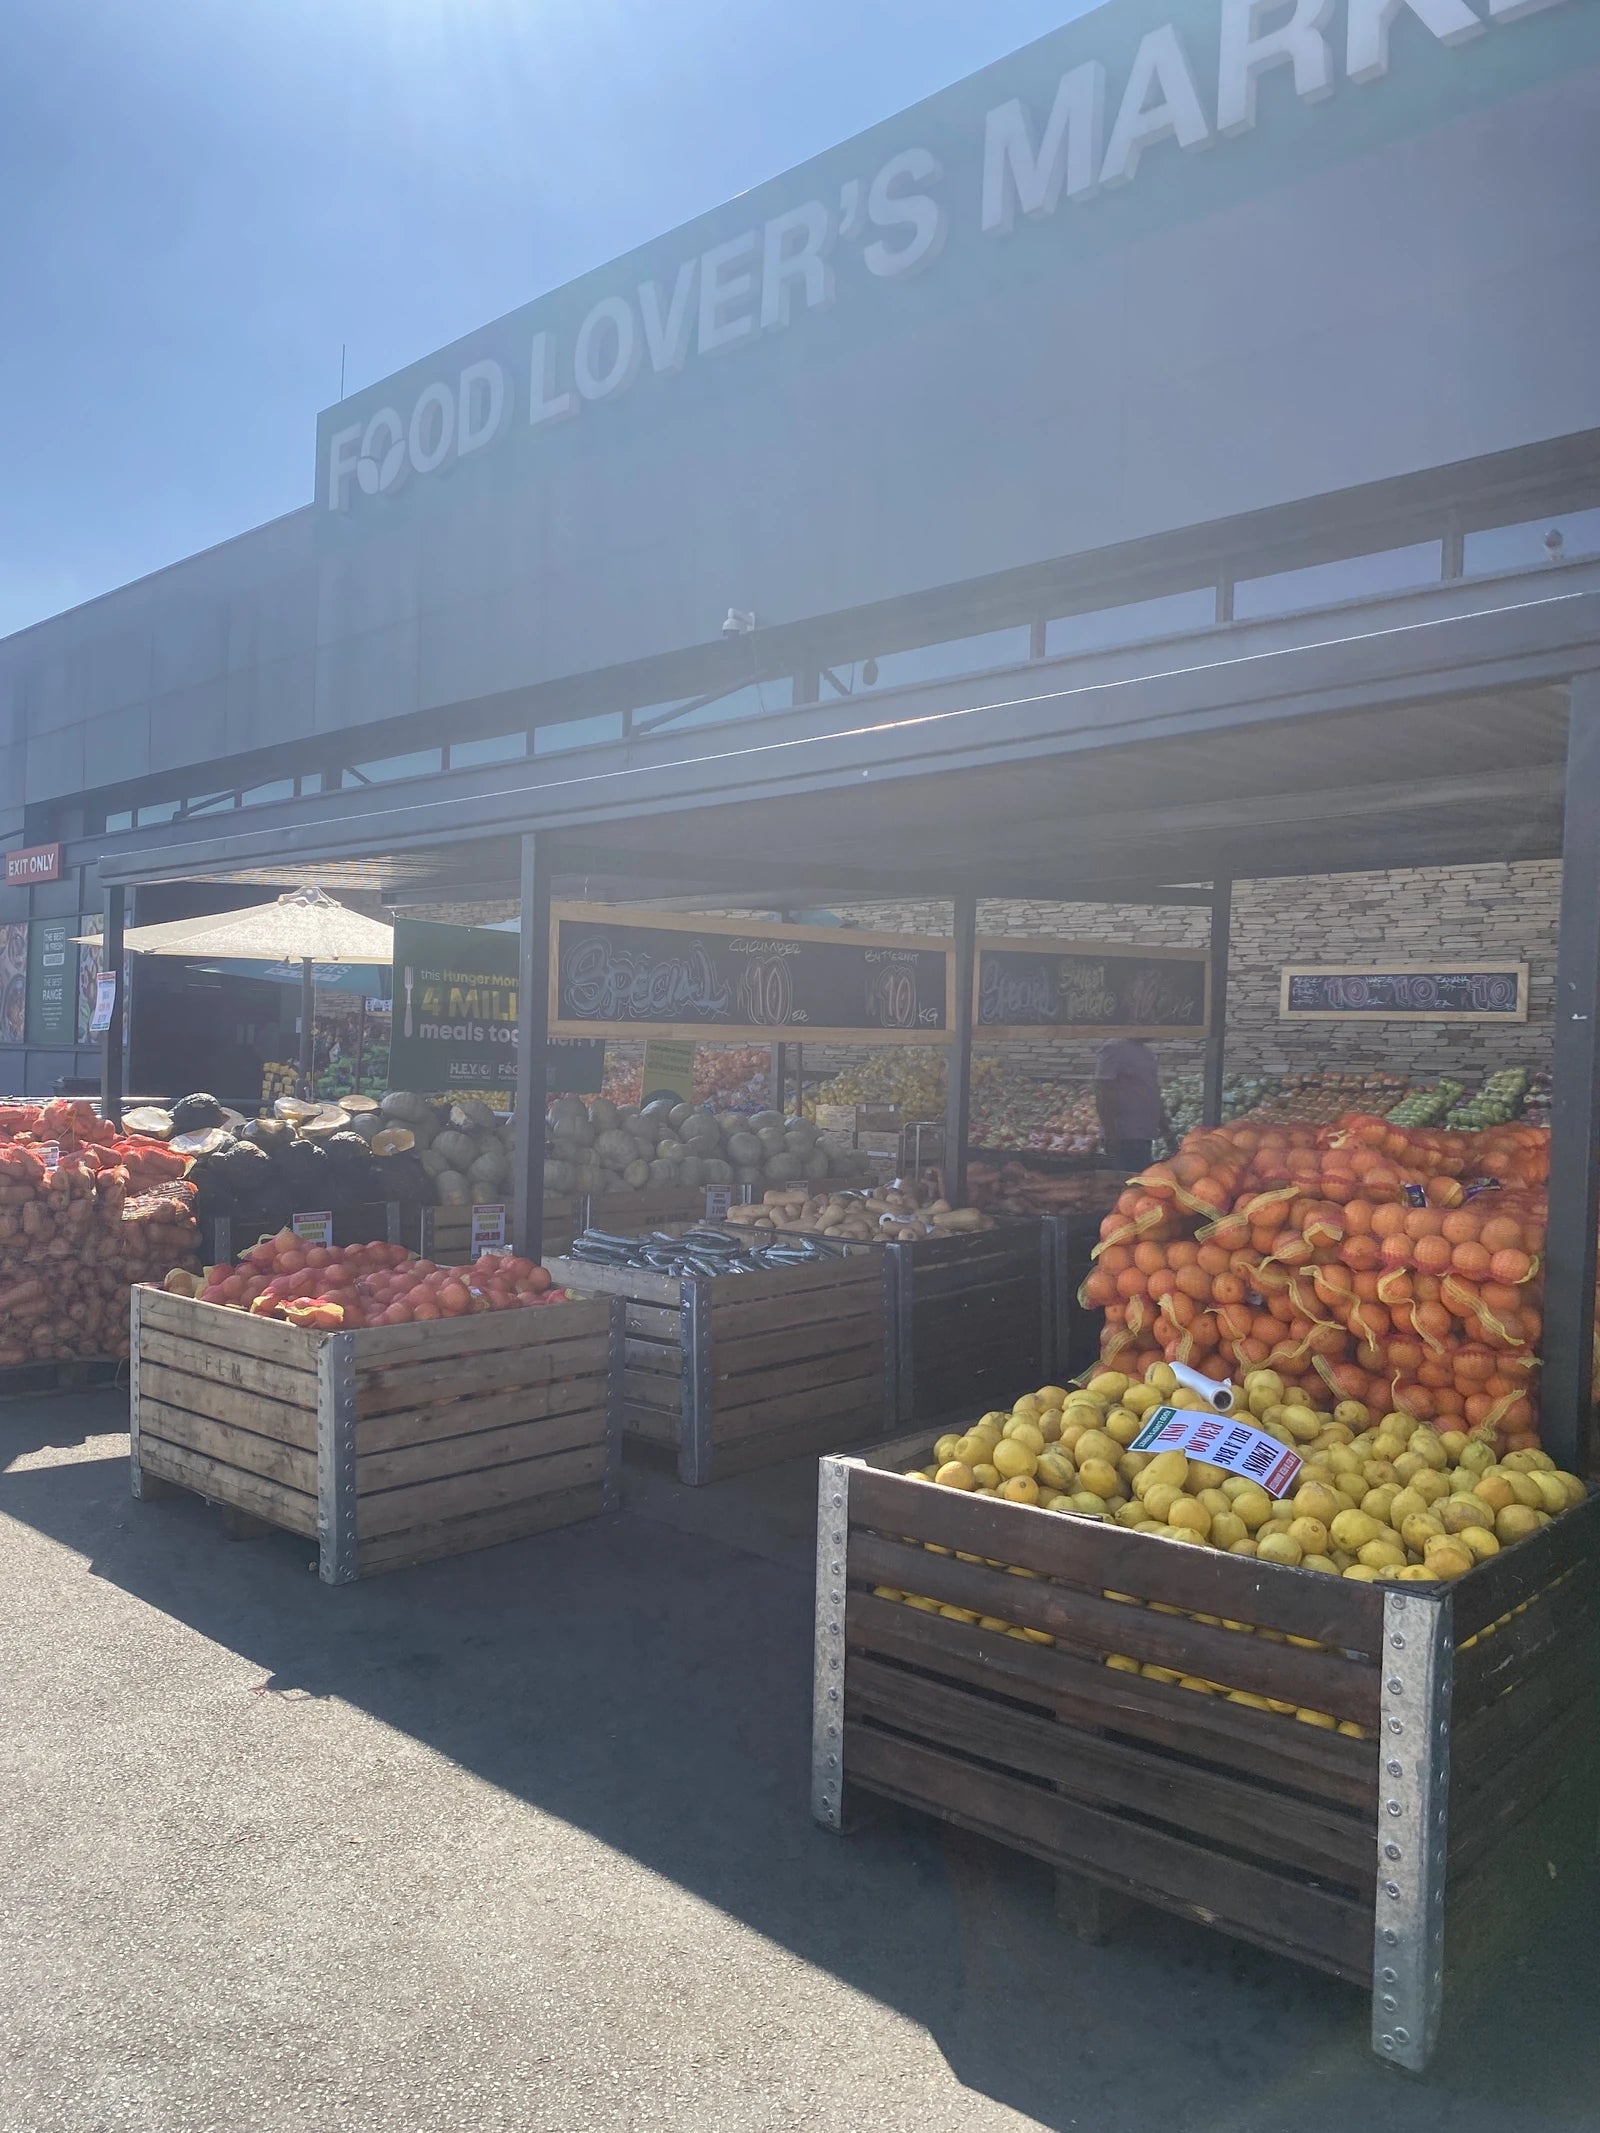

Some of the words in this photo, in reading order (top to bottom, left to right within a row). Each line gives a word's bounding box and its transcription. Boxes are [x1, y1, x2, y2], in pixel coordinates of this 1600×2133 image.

[328, 359, 513, 512] FOOD
[530, 148, 945, 427] LOVER'S
[981, 0, 1570, 237] MAR
[8, 858, 29, 877] EXIT
[30, 853, 55, 873] ONLY
[421, 969, 440, 981] this
[443, 970, 490, 987] Hunger
[492, 974, 519, 987] Mon
[42, 988, 63, 1001] RANGE
[421, 987, 440, 1016] 4
[449, 987, 519, 1022] MILL
[749, 960, 788, 1025] 10
[420, 1021, 484, 1042] meals
[488, 1024, 519, 1048] tog
[1157, 1423, 1189, 1443] ONLY
[1184, 1421, 1224, 1453] R30.00
[1224, 1440, 1242, 1450] A
[1228, 1427, 1253, 1444] FILL
[1212, 1446, 1239, 1466] BAG
[1242, 1441, 1279, 1477] LEMONS
